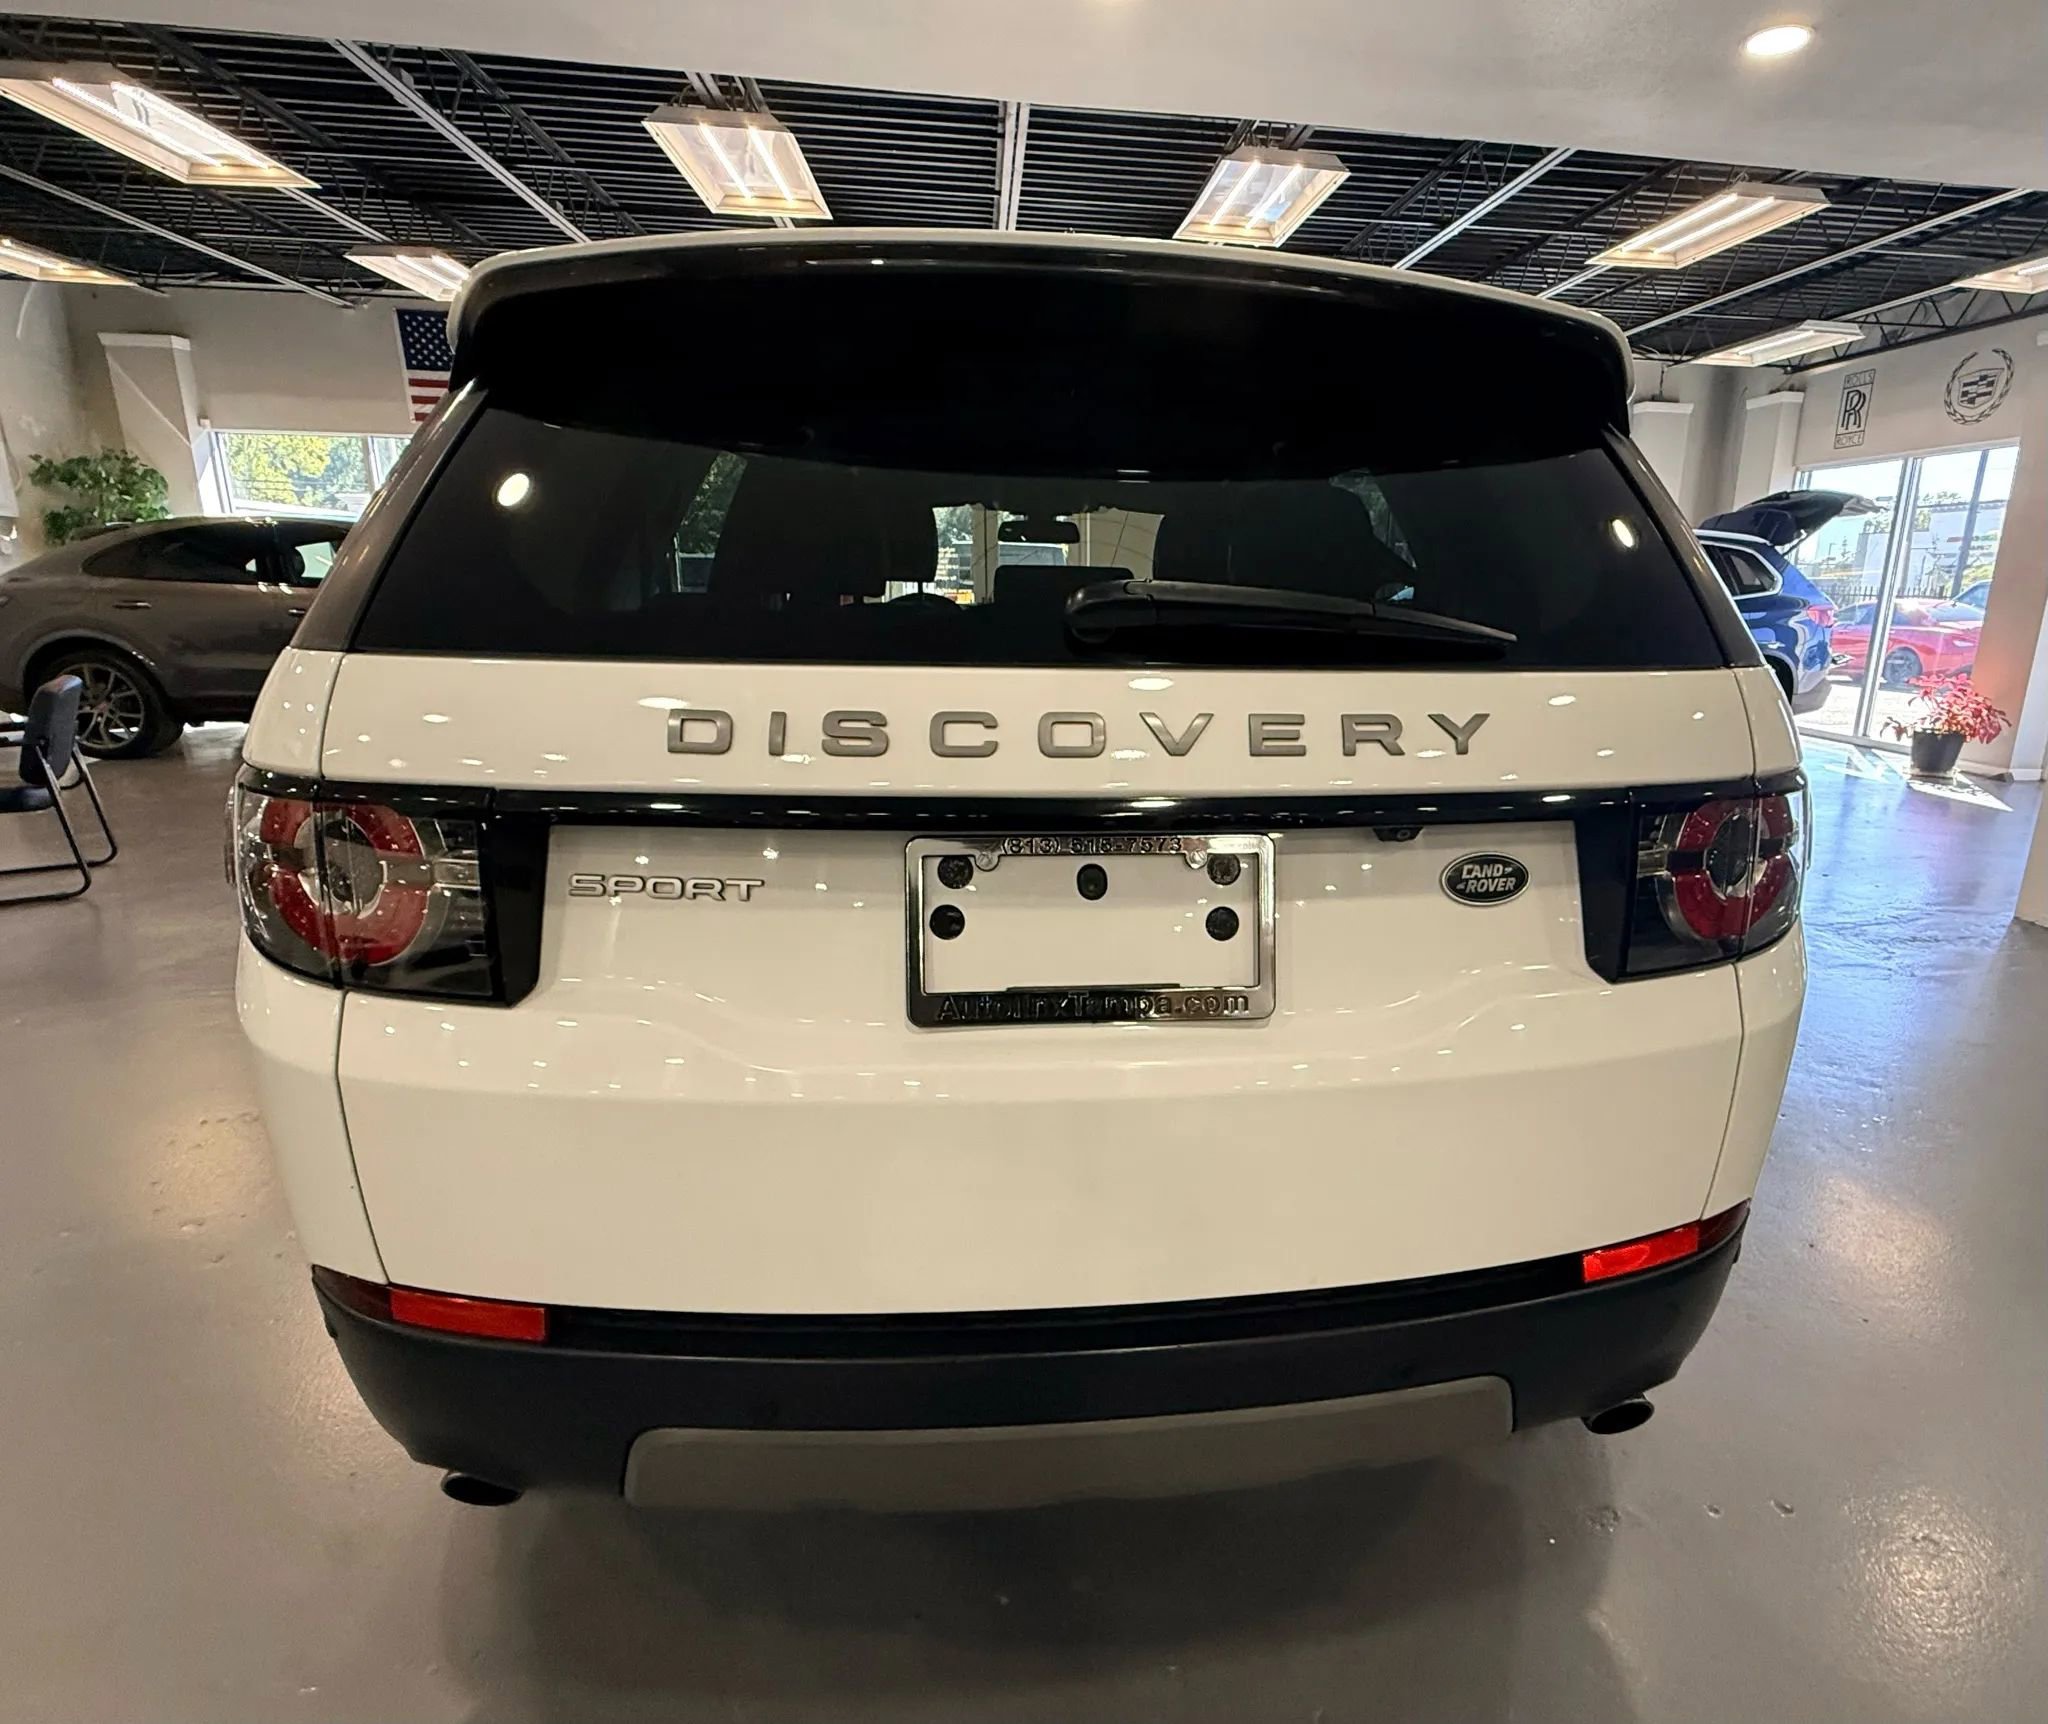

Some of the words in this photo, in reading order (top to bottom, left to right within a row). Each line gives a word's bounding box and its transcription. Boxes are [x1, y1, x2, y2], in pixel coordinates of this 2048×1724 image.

[668, 709, 1490, 757] DISCOVERY
[1001, 837, 1061, 856] (813)
[1461, 863, 1504, 879] LAND
[569, 873, 765, 902] SPORT
[1465, 877, 1516, 893] ROVER
